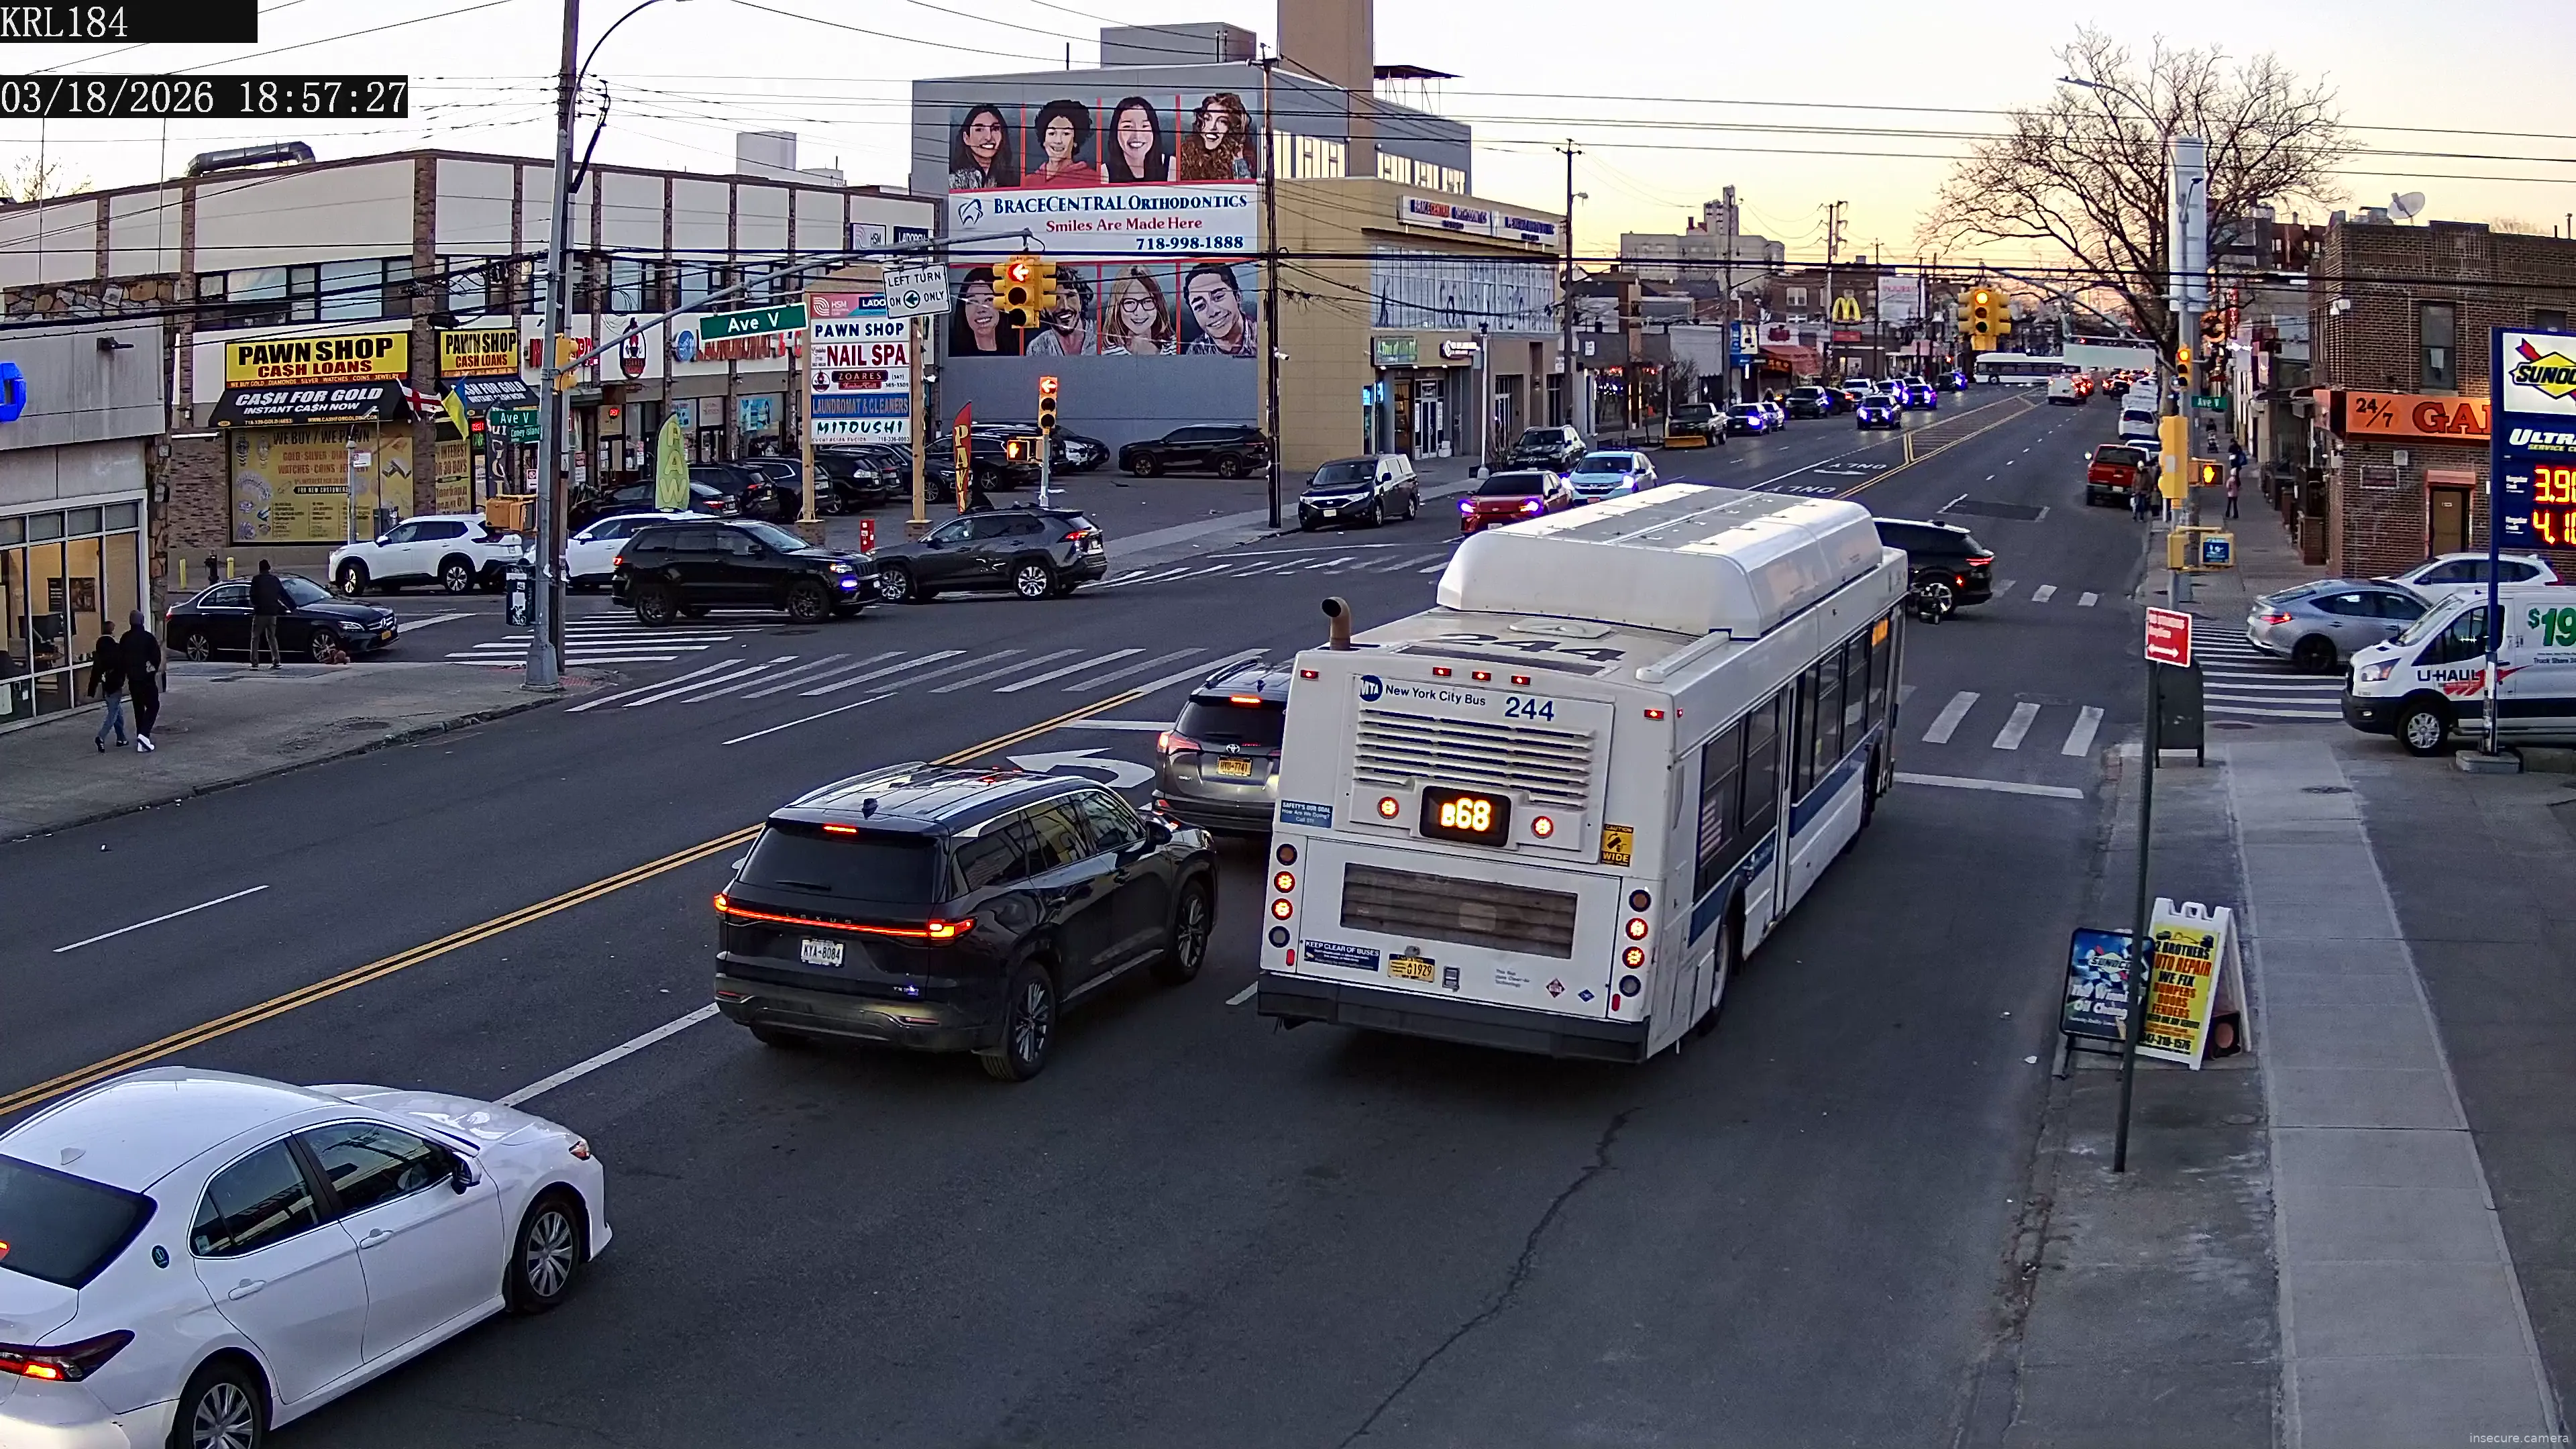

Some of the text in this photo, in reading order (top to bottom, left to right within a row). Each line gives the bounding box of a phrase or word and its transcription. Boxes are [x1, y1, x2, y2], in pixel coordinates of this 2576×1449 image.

[1046, 217, 1202, 232] Smiles Are Made Here
[1136, 236, 1243, 250] 718-998-1888
[888, 272, 941, 287] LEFT TURN
[890, 291, 944, 307] ON ONLY
[728, 312, 779, 333] Ave V
[815, 323, 904, 337] PAWN SHOP
[239, 337, 393, 366] PAWN SHOP
[445, 334, 480, 354] PAWN
[482, 333, 517, 354] SHOP
[455, 354, 508, 368] CA$H LOANS
[827, 343, 907, 366] NAIL SPA
[258, 360, 372, 378] CA$H LOANS
[839, 372, 881, 380] ZOARES
[480, 380, 526, 395] FOR GOLD
[235, 388, 383, 407] CA$H FOR GOLD
[2197, 397, 2219, 407] Ave V
[244, 405, 295, 415] INSTANT
[329, 402, 360, 411] NOW
[812, 397, 908, 415] LAUNDROMAT & CLEANERS
[2355, 397, 2394, 428] 24/7
[500, 412, 529, 424] Ave V
[511, 427, 540, 438] Coney Island
[817, 421, 903, 435] MITOUSHI
[274, 431, 288, 445] WE
[289, 431, 310, 445] BUY
[321, 431, 338, 443] WE
[339, 429, 369, 443] PWN
[2509, 428, 2576, 445] ULTR
[283, 451, 301, 461] GOLD
[303, 451, 327, 460] SILVER
[441, 443, 467, 460] INTEREST
[278, 464, 335, 474] WATCHES COINS
[452, 458, 468, 474] DAYS
[1420, 633, 1626, 661] 244
[1360, 679, 1554, 721] MTA New York City Bus 244
[1441, 797, 1491, 831] B68
[1603, 852, 1629, 862] WIDE
[1324, 943, 1346, 952] CLEAR
[1356, 948, 1379, 957] BUSES
[2162, 942, 2210, 960] BROTHERS
[2154, 952, 2212, 977] UTO REPAIR
[2158, 971, 2195, 987] WE FIX
